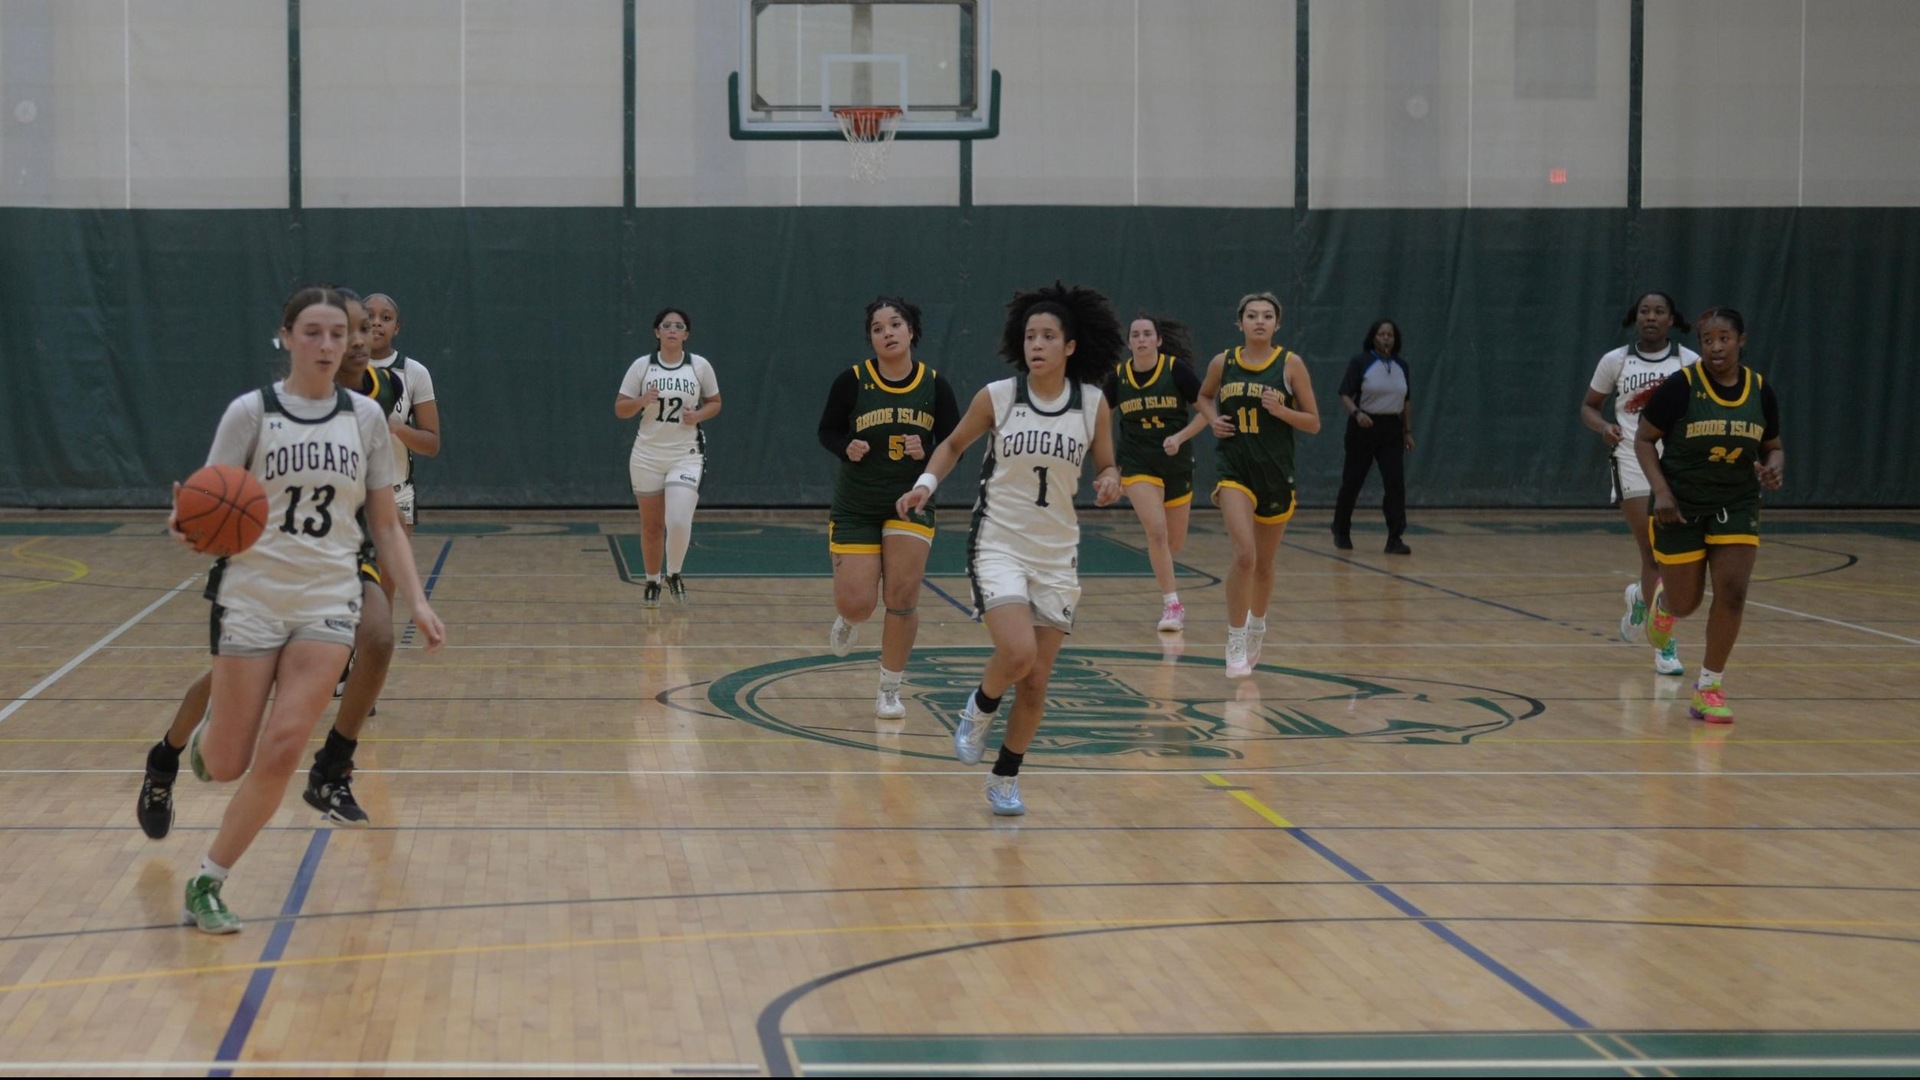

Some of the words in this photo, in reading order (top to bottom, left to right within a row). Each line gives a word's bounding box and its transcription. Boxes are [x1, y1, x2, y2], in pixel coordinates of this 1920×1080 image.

[1144, 395, 1178, 409] ISLAND
[1246, 382, 1285, 406] ISLND
[655, 397, 683, 424] 12
[856, 407, 894, 433] RHODE
[897, 407, 935, 431] ISLAND
[1237, 406, 1259, 434] 11
[1685, 419, 1727, 438] RHODE
[265, 441, 359, 482] COUGARS
[888, 435, 905, 461] 5
[1003, 430, 1084, 467] COUGARS
[1032, 465, 1050, 508] 1
[279, 484, 336, 538] 13
